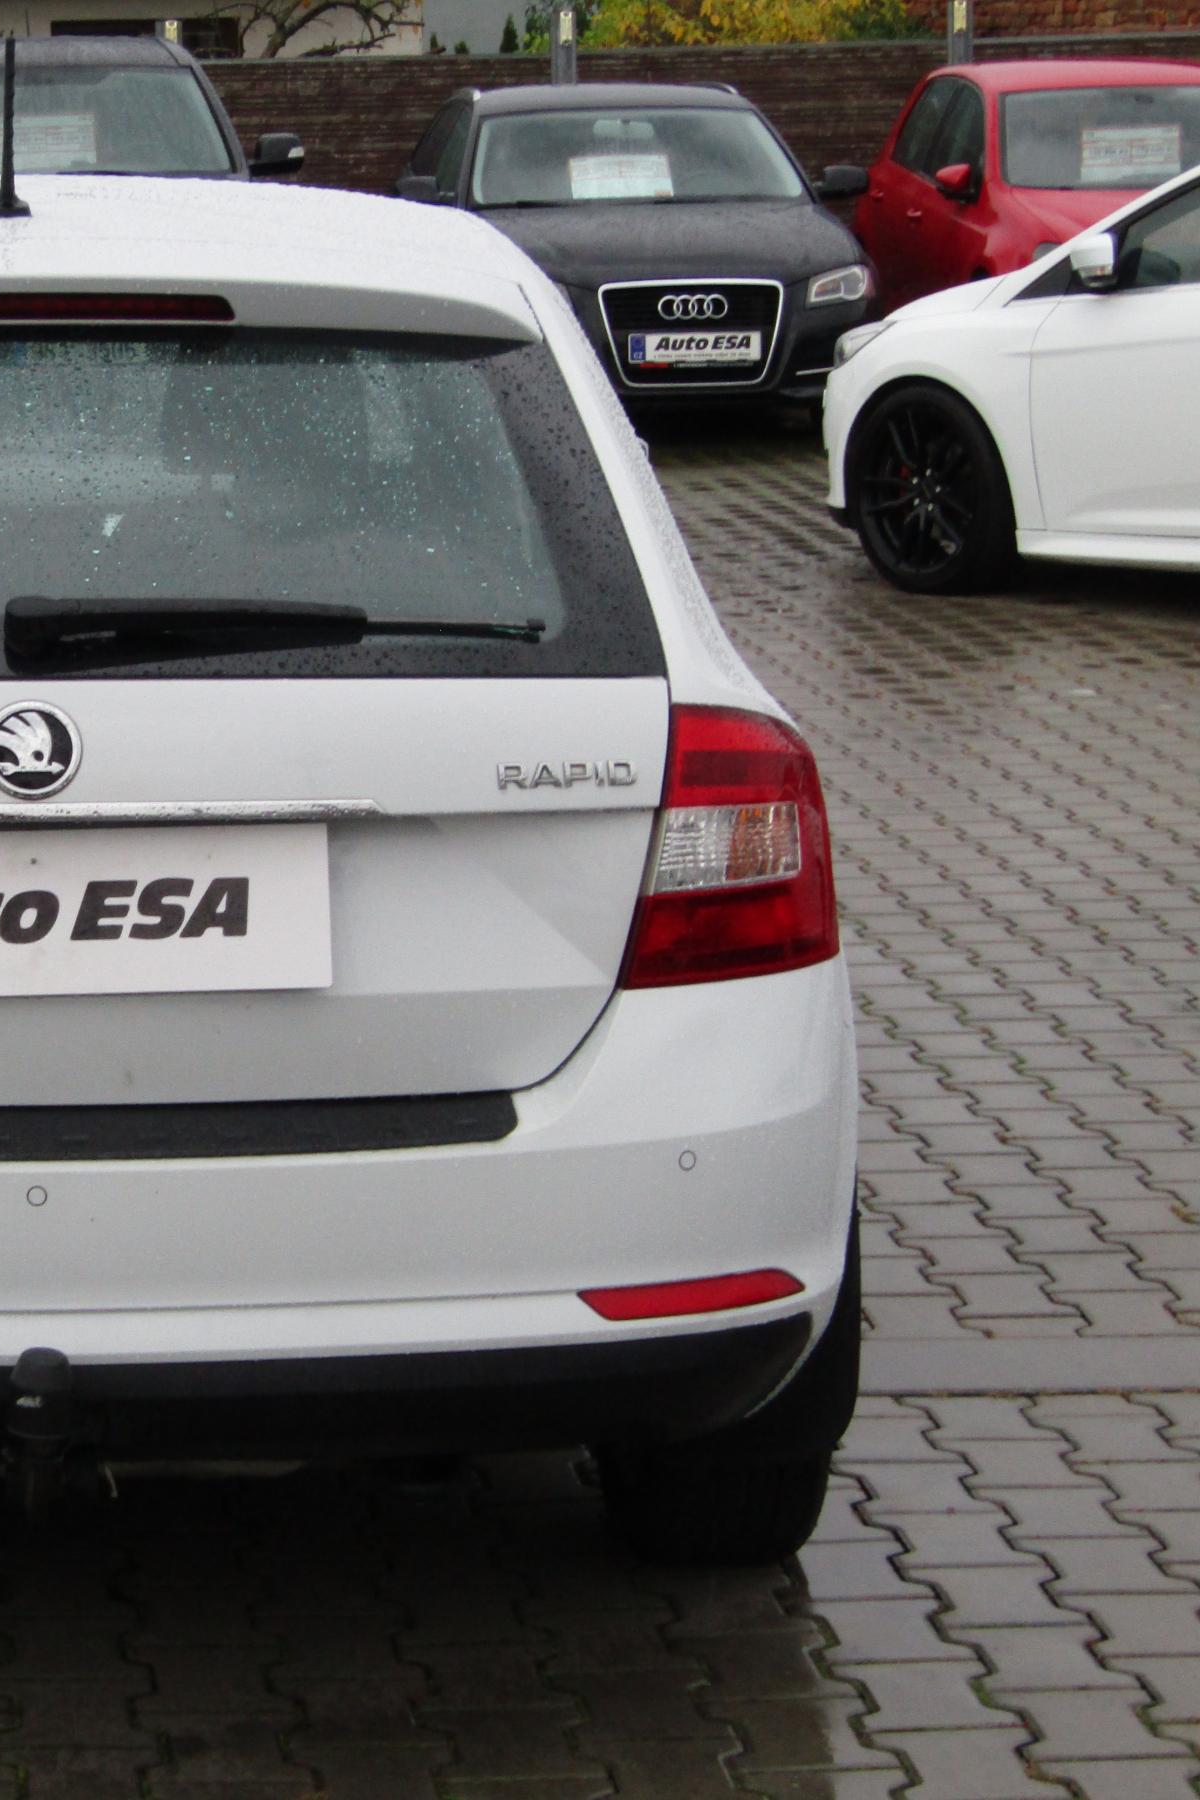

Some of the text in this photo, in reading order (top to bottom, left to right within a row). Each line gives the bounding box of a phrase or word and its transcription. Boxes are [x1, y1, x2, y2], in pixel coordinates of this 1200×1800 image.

[655, 334, 751, 351] Auto ESA
[633, 351, 643, 359] CZ
[497, 760, 638, 790] RAPID
[70, 877, 249, 941] ESA
